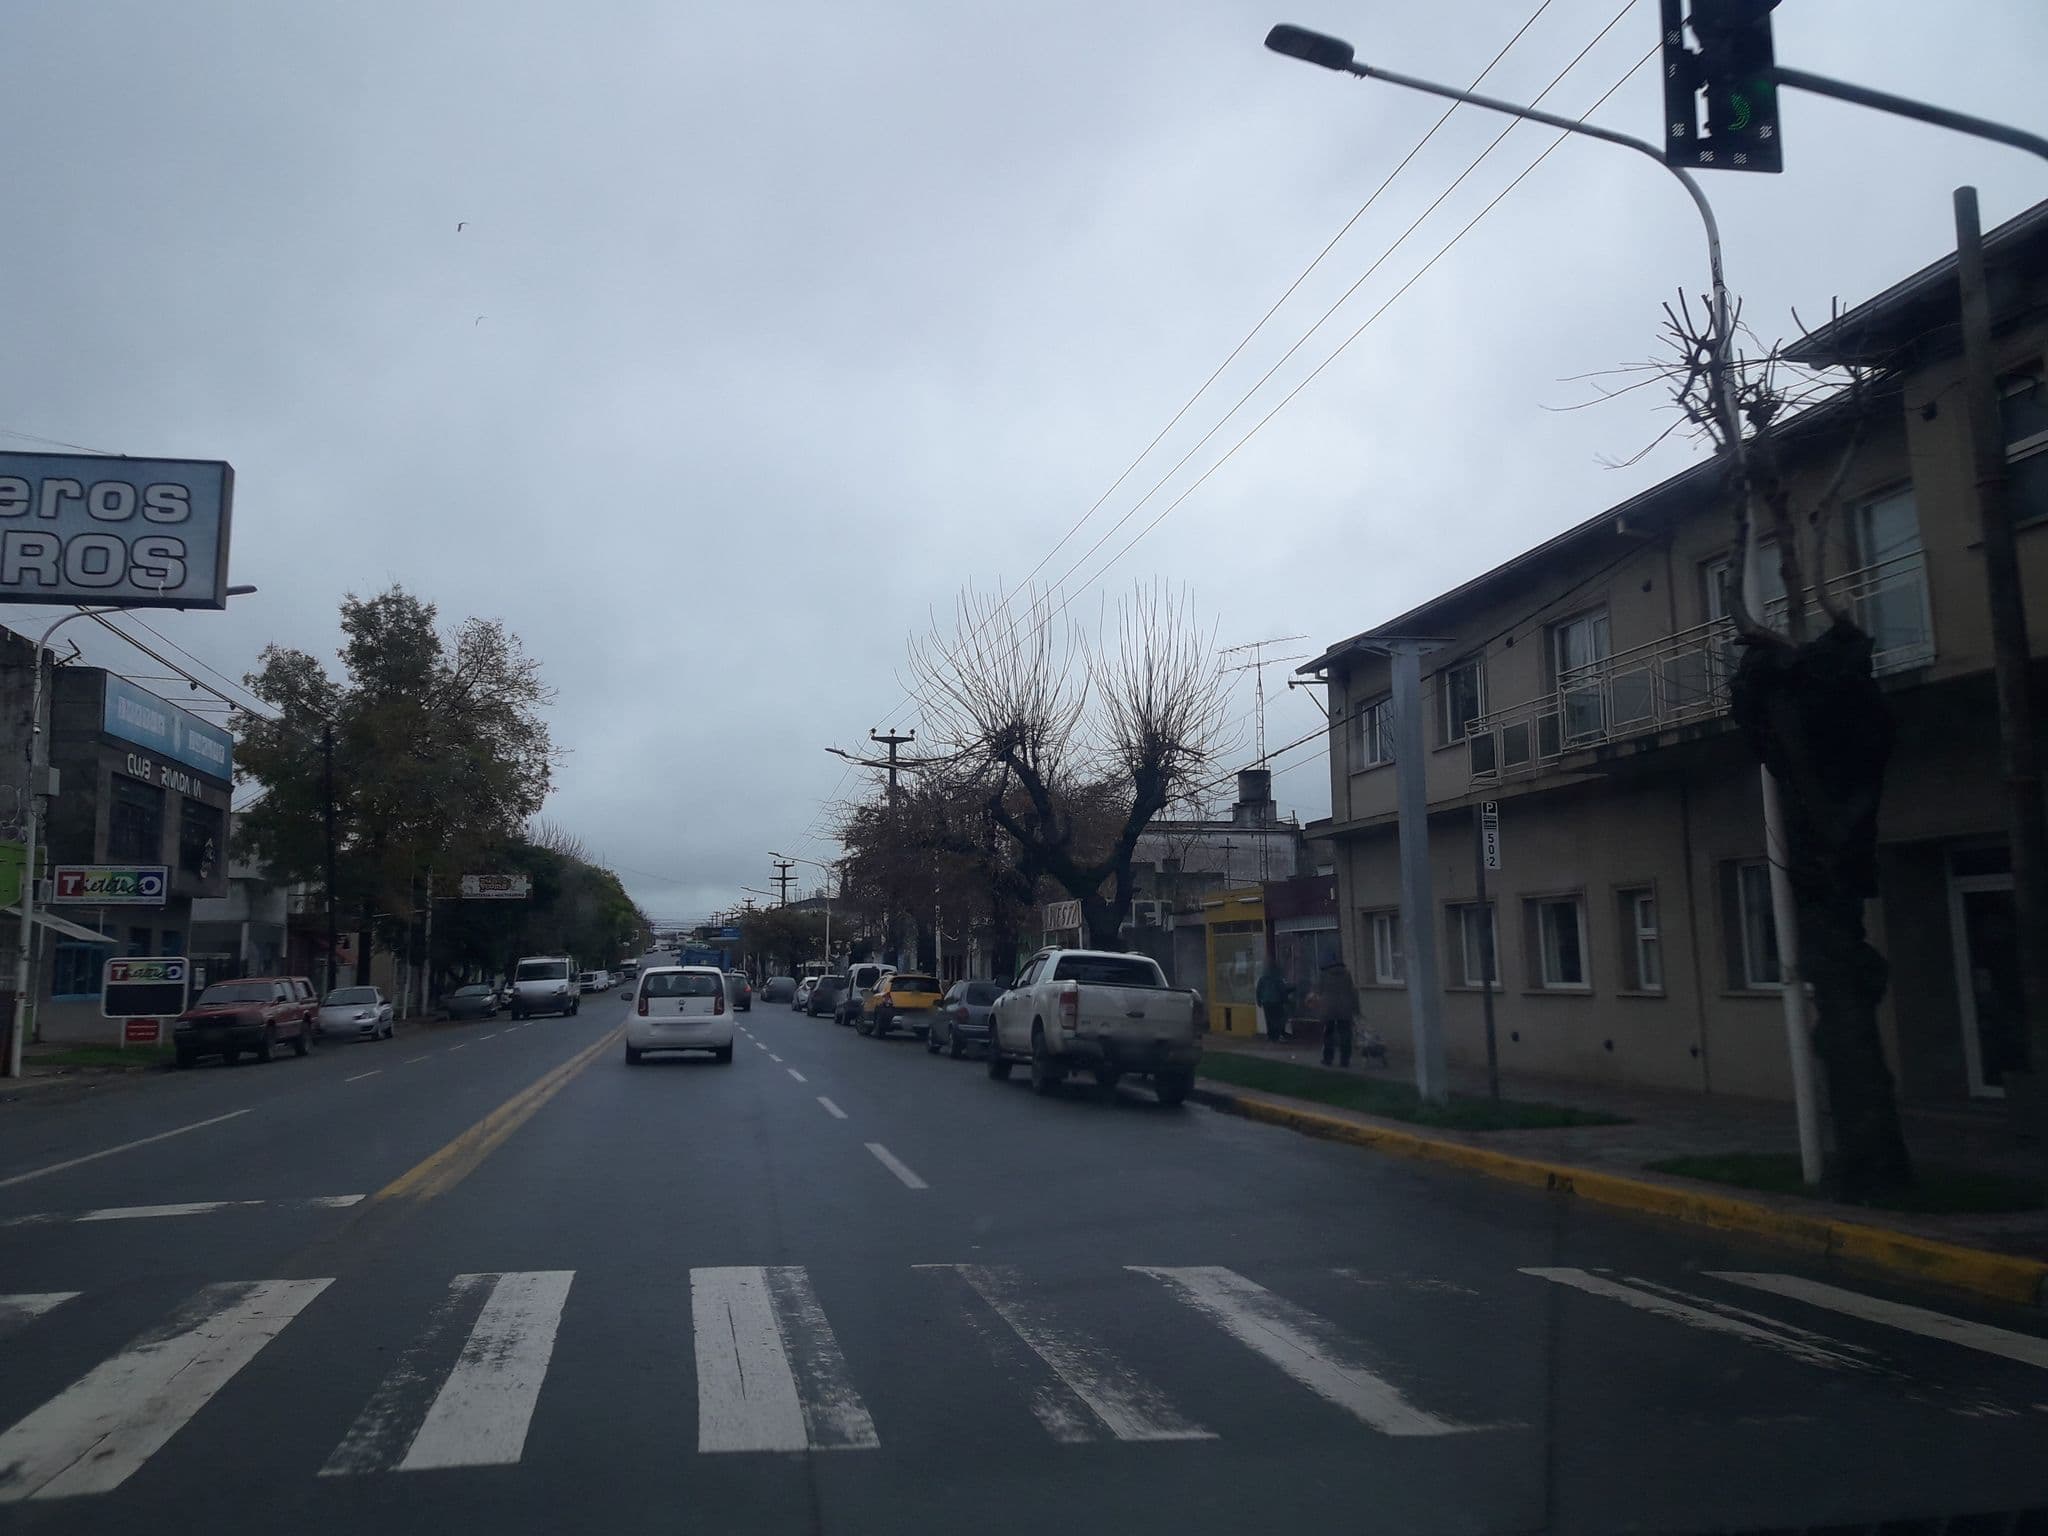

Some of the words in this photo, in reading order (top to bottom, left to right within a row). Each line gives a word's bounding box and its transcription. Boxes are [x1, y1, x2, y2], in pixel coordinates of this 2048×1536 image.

[0, 530, 187, 590] ROS
[1486, 802, 1493, 813] P
[1487, 833, 1495, 867] 502
